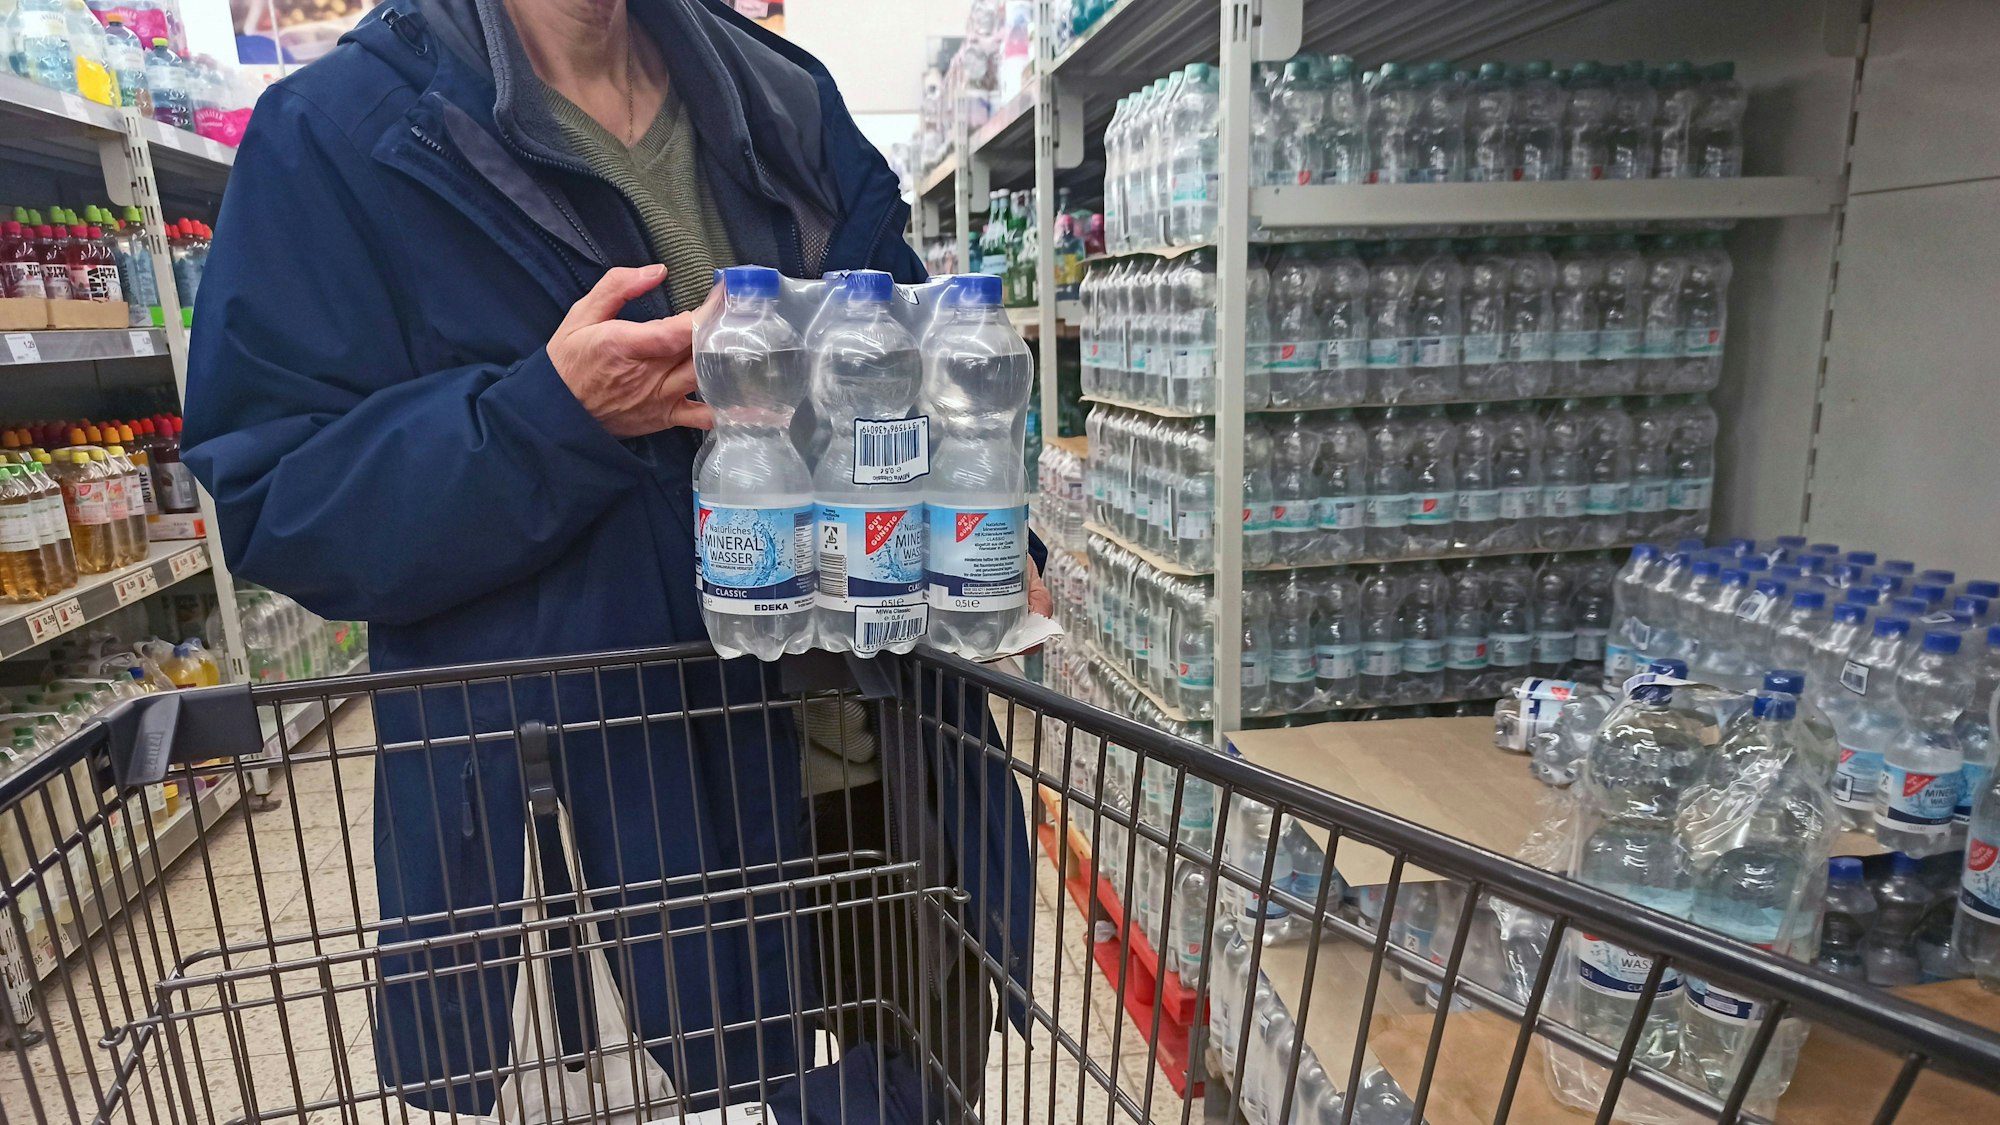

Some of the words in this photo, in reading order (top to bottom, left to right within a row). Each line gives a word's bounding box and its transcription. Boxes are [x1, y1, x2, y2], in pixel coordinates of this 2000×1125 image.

[868, 515, 882, 531] GUT
[958, 515, 968, 526] GUT
[710, 524, 751, 535] Natürliches
[705, 534, 764, 551] MINERAL
[710, 549, 753, 564] WASSER
[716, 588, 747, 598] CLASSIC
[754, 603, 789, 611] EDEKA
